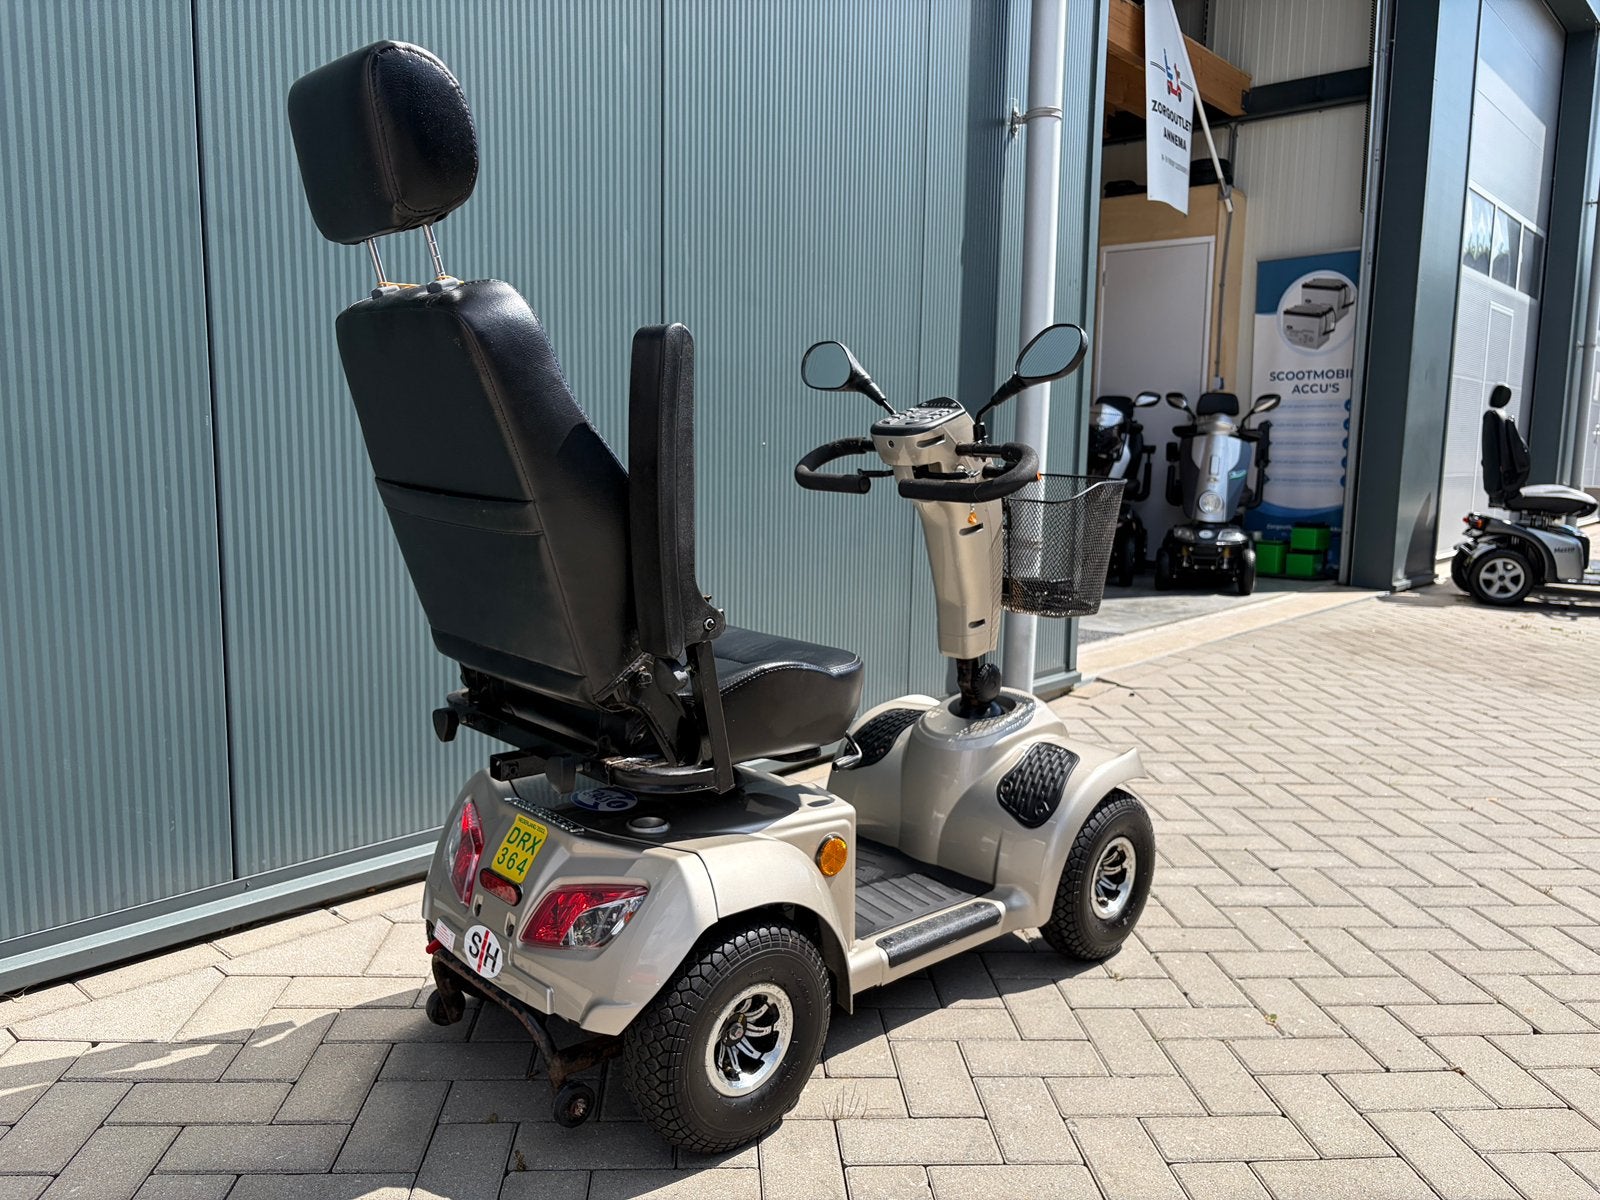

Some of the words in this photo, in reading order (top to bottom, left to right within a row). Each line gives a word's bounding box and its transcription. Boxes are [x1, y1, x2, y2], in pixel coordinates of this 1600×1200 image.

[1151, 99, 1192, 132] ZORGOUTLET
[1163, 126, 1187, 151] ANNEMA
[1291, 382, 1340, 394] ACCU'S
[506, 826, 542, 856] DRX
[497, 846, 529, 876] 364
